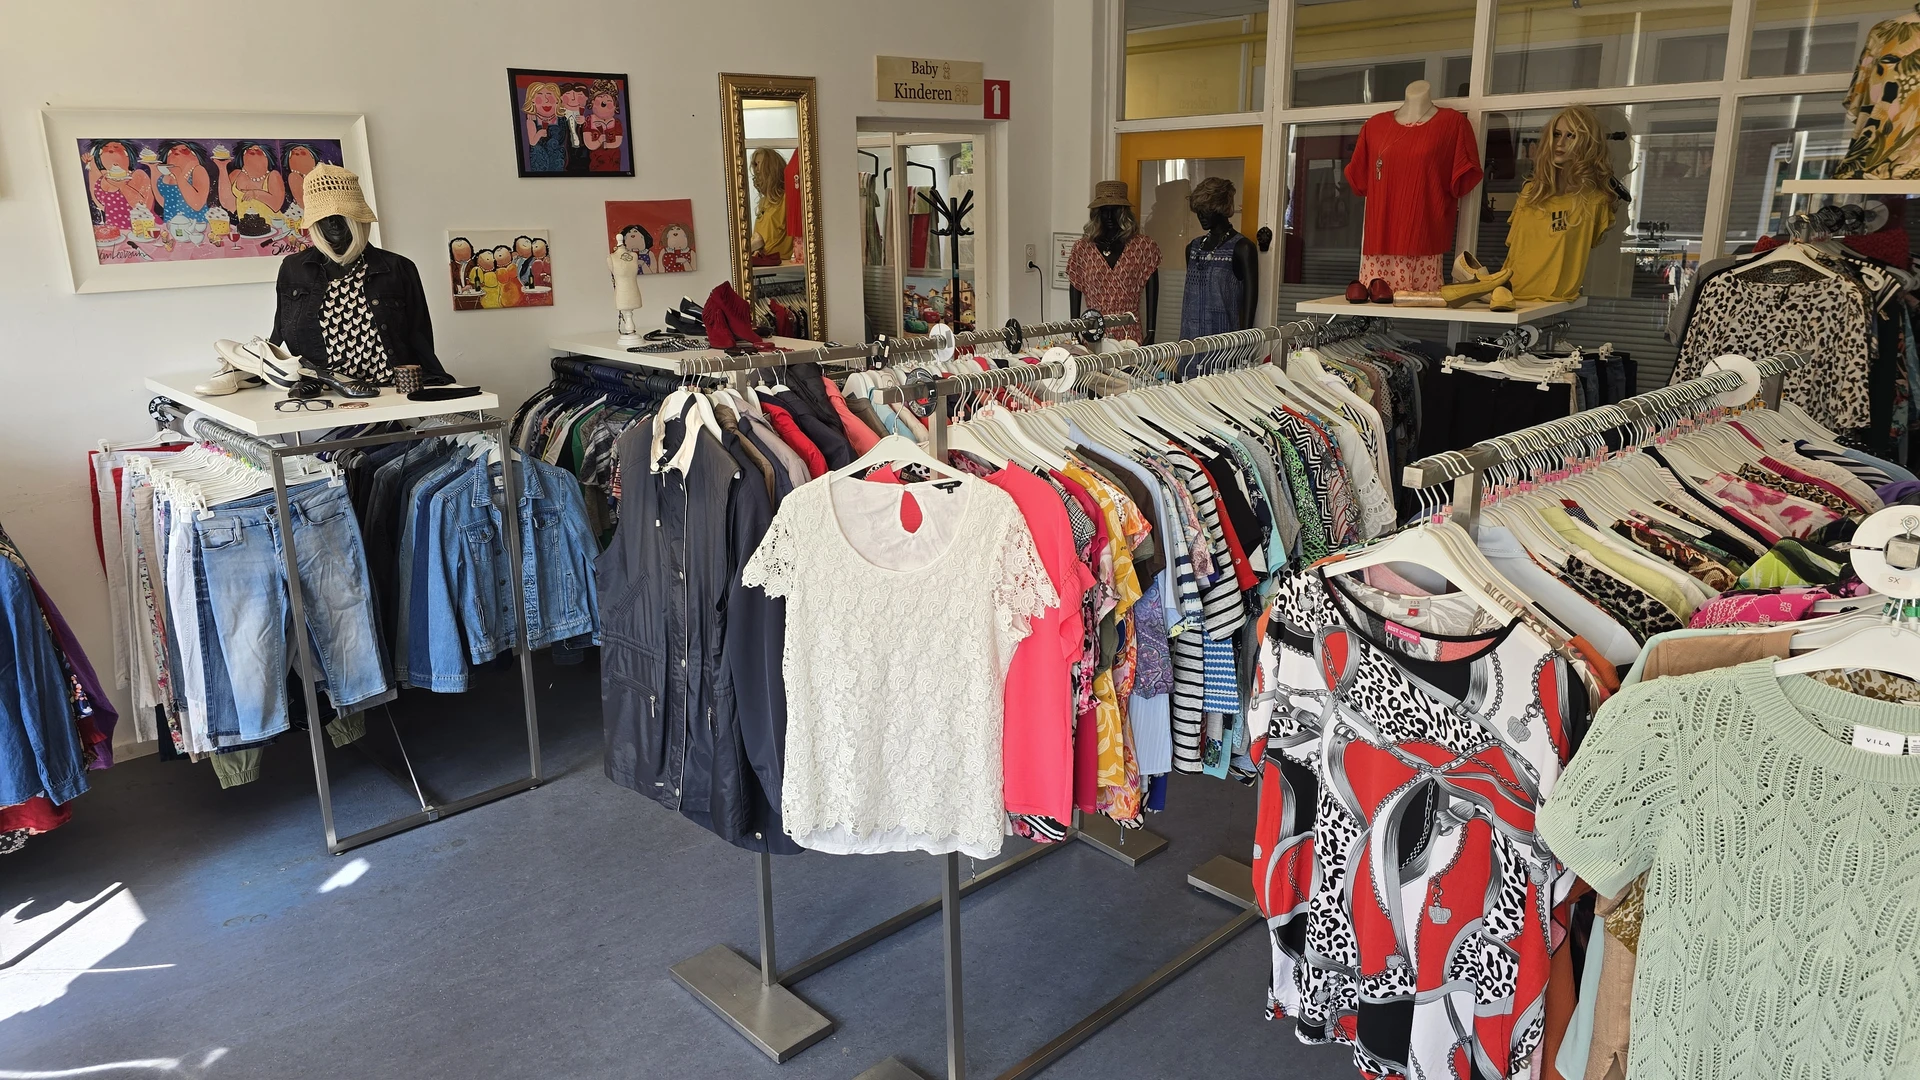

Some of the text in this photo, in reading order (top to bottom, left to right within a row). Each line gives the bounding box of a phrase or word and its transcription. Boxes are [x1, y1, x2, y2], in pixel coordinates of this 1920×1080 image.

[911, 61, 939, 78] Baby
[894, 83, 953, 101] Kinderen
[1888, 577, 1901, 585] XS
[1866, 738, 1891, 747] VILA
